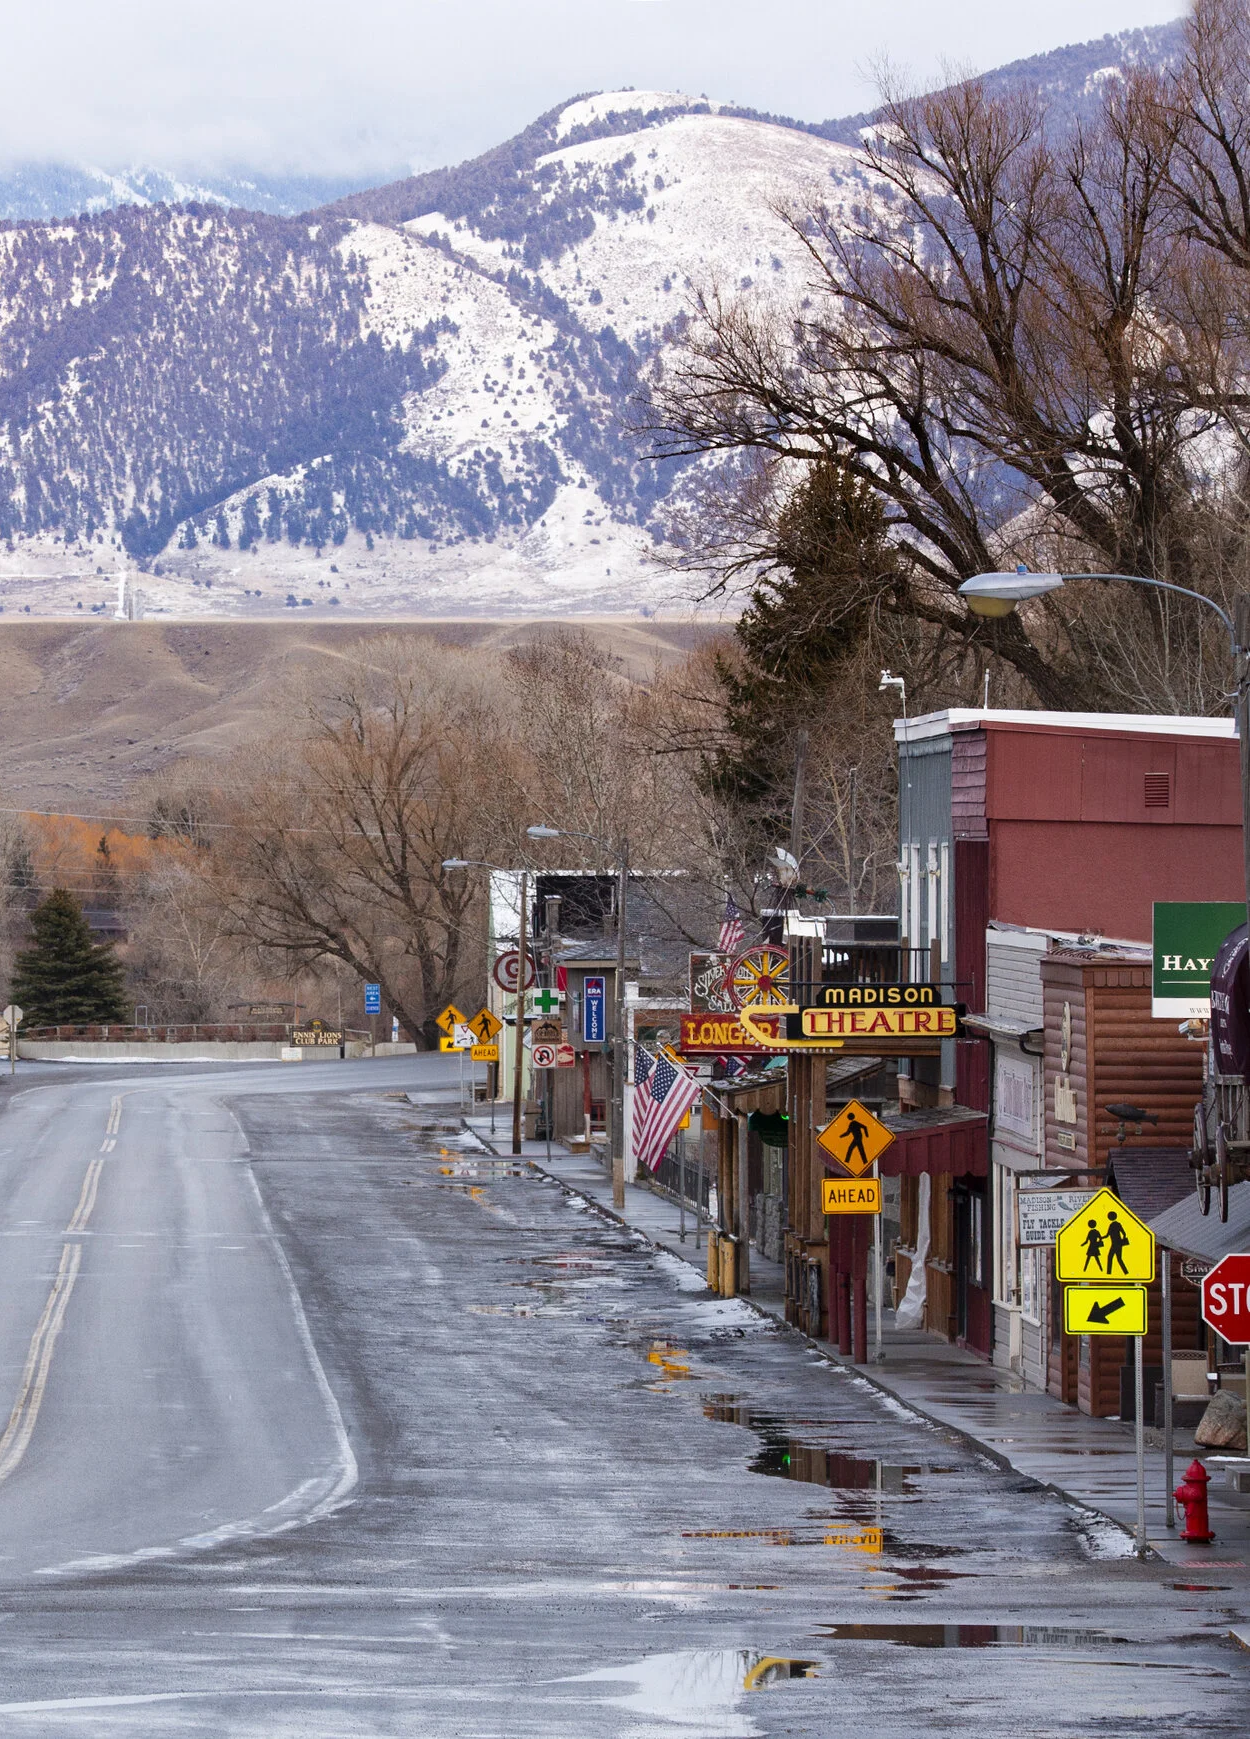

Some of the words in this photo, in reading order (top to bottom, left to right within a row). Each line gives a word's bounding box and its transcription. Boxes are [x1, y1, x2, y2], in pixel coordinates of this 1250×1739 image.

[1162, 955, 1214, 971] HAY
[825, 987, 933, 1003] MADISON
[590, 999, 598, 1039] WELCOME
[804, 1011, 954, 1033] THEATRE
[473, 1048, 496, 1056] AHEAD
[828, 1189, 875, 1203] AHEAD
[1020, 1196, 1052, 1205] MADISON
[1027, 1203, 1056, 1211] FISHING
[1022, 1219, 1035, 1229] FLY
[1039, 1218, 1065, 1229] TACKLE
[1025, 1230, 1045, 1241] GUIDE
[1209, 1283, 1250, 1316] ST
